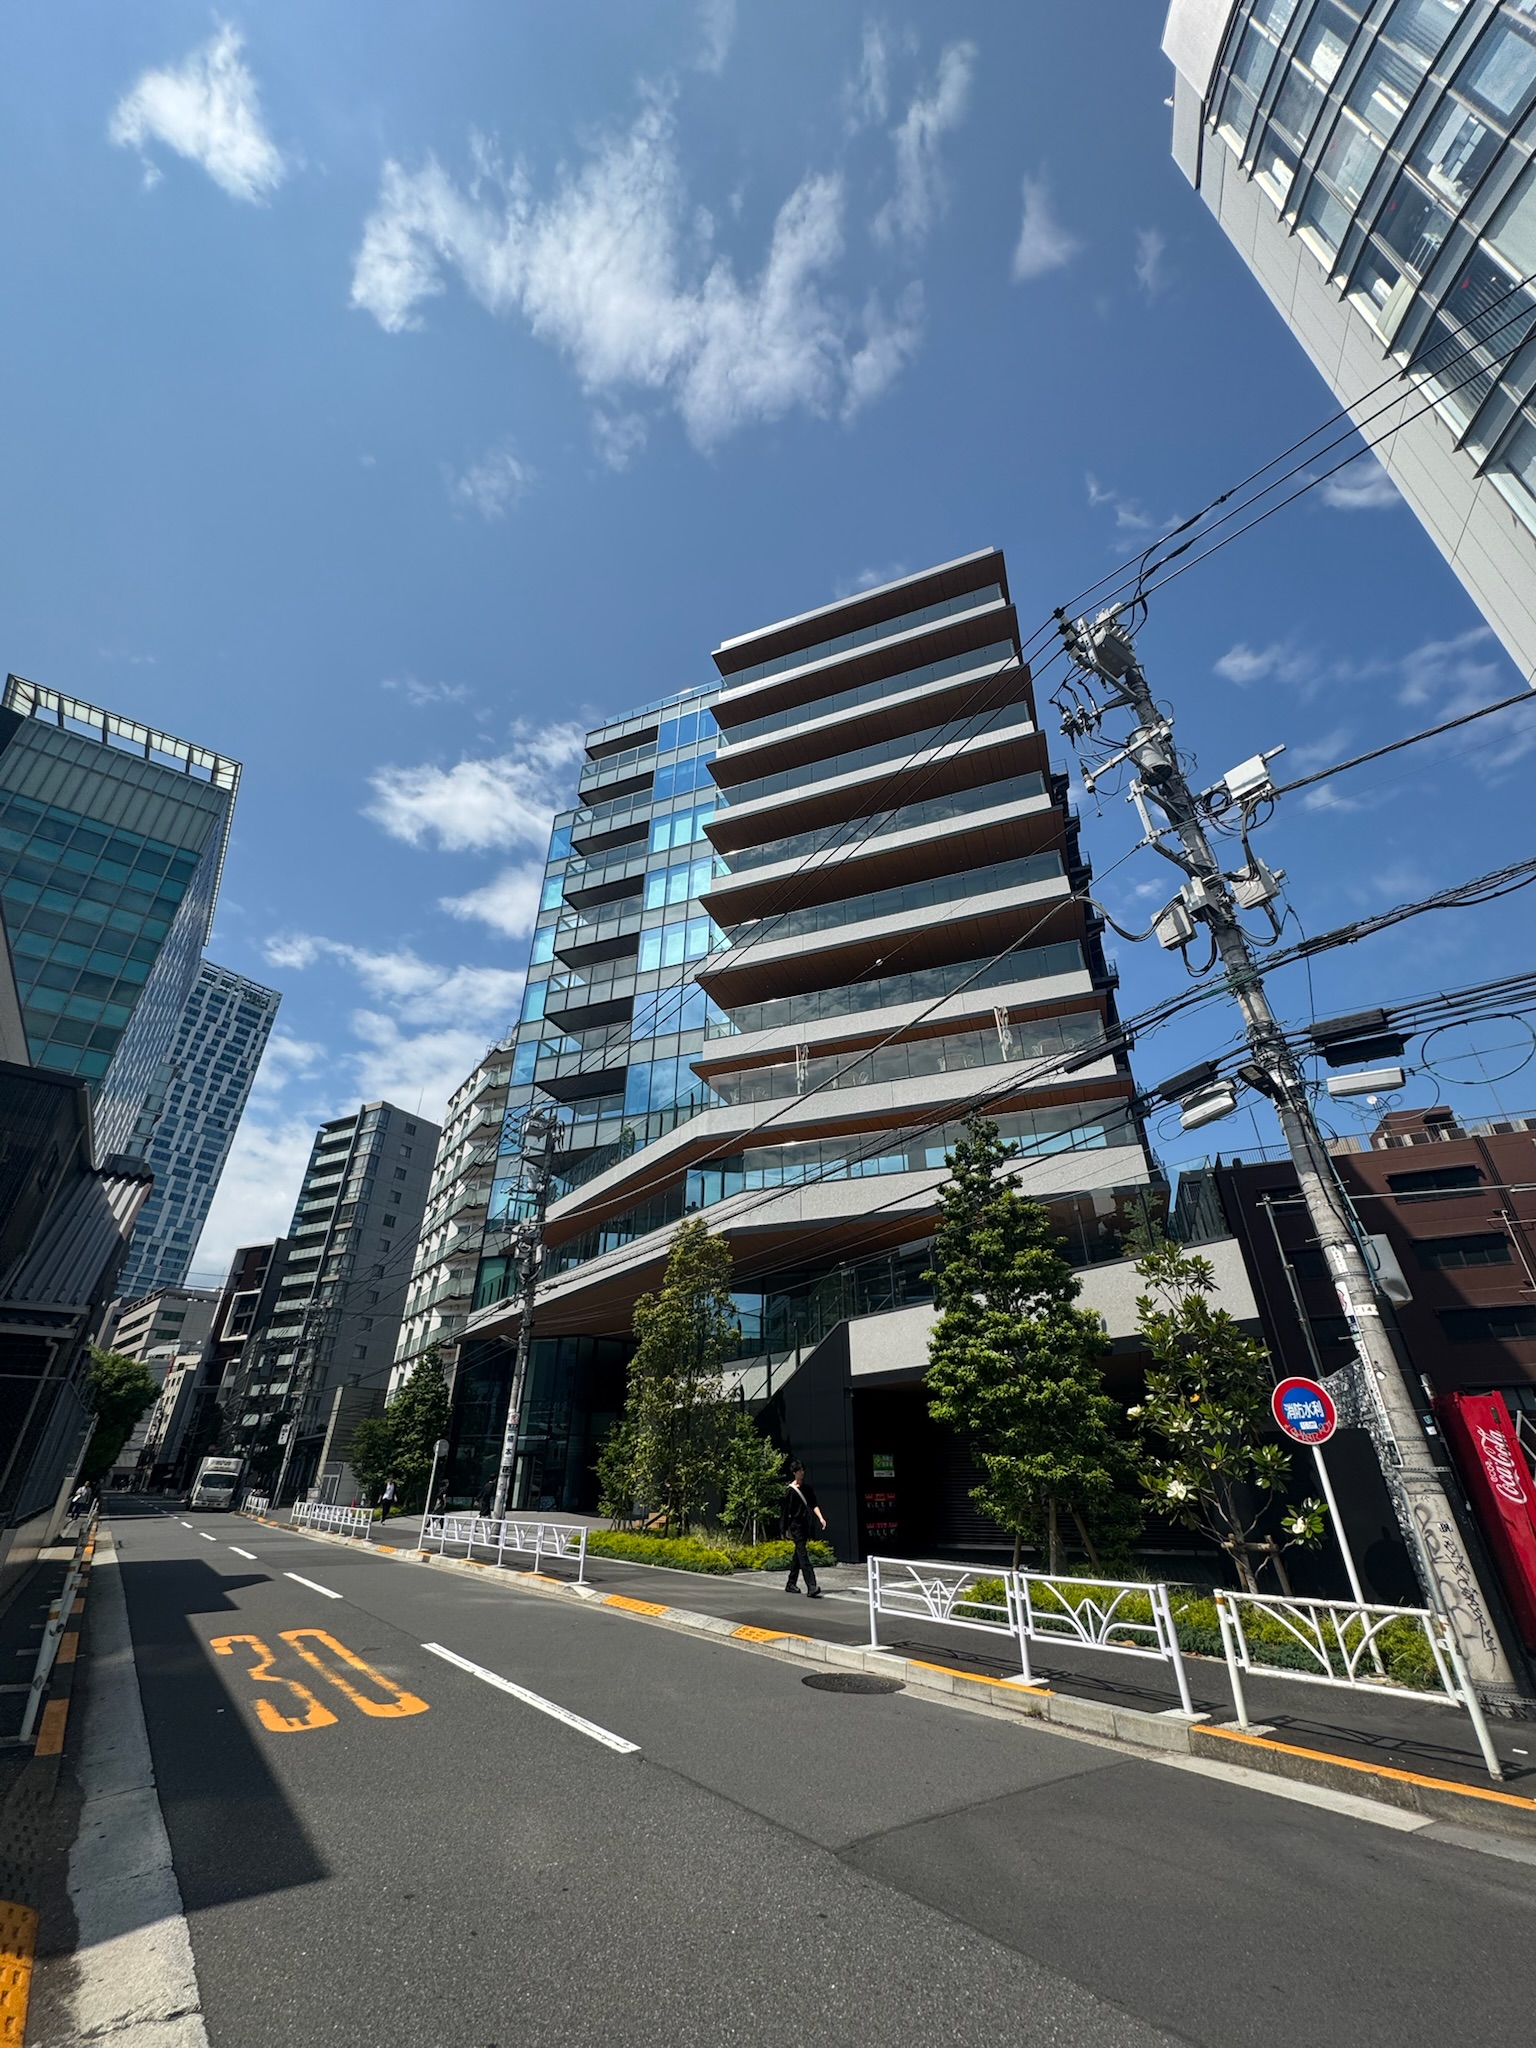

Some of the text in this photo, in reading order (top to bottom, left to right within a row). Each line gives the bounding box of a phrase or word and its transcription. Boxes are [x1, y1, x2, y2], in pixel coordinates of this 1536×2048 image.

[1283, 1400, 1325, 1420] 消防水利
[209, 1628, 430, 1733] 30
